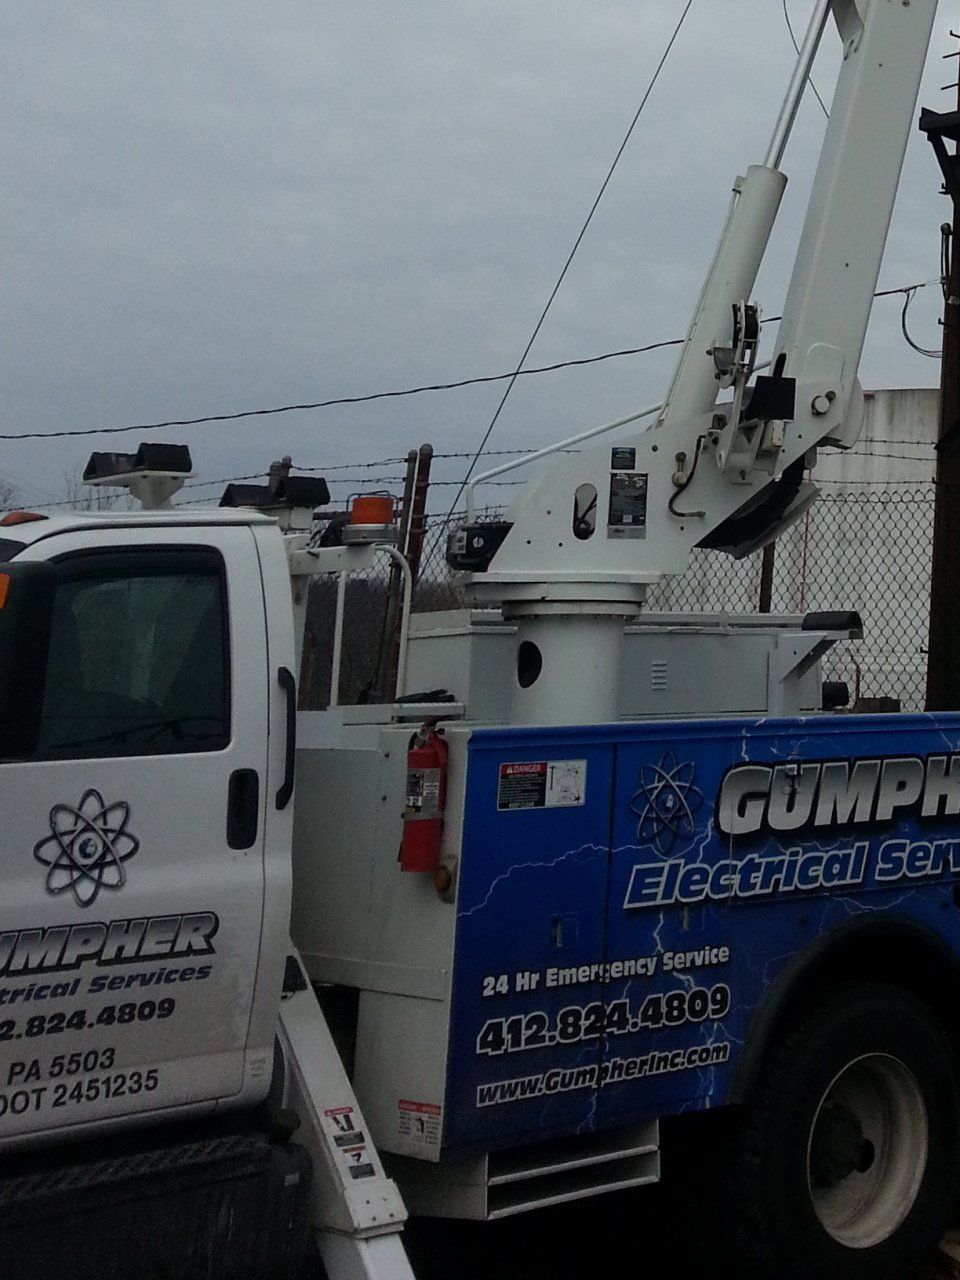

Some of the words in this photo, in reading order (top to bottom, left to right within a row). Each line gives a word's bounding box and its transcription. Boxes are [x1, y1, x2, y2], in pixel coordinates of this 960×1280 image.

[513, 764, 541, 773] DANGER
[623, 840, 871, 909] Electrical
[0, 910, 219, 977] MPHER
[87, 965, 213, 994] Services
[482, 974, 509, 997] 24
[515, 971, 540, 992] Hr
[546, 954, 657, 988] Emergency
[662, 945, 730, 971] Service
[476, 982, 731, 1056] 412.824.4809
[7, 1059, 41, 1086] PA
[49, 1047, 116, 1078] 5503
[52, 1069, 159, 1108] 2451235
[476, 1042, 731, 1108] www.GumpherInc.com
